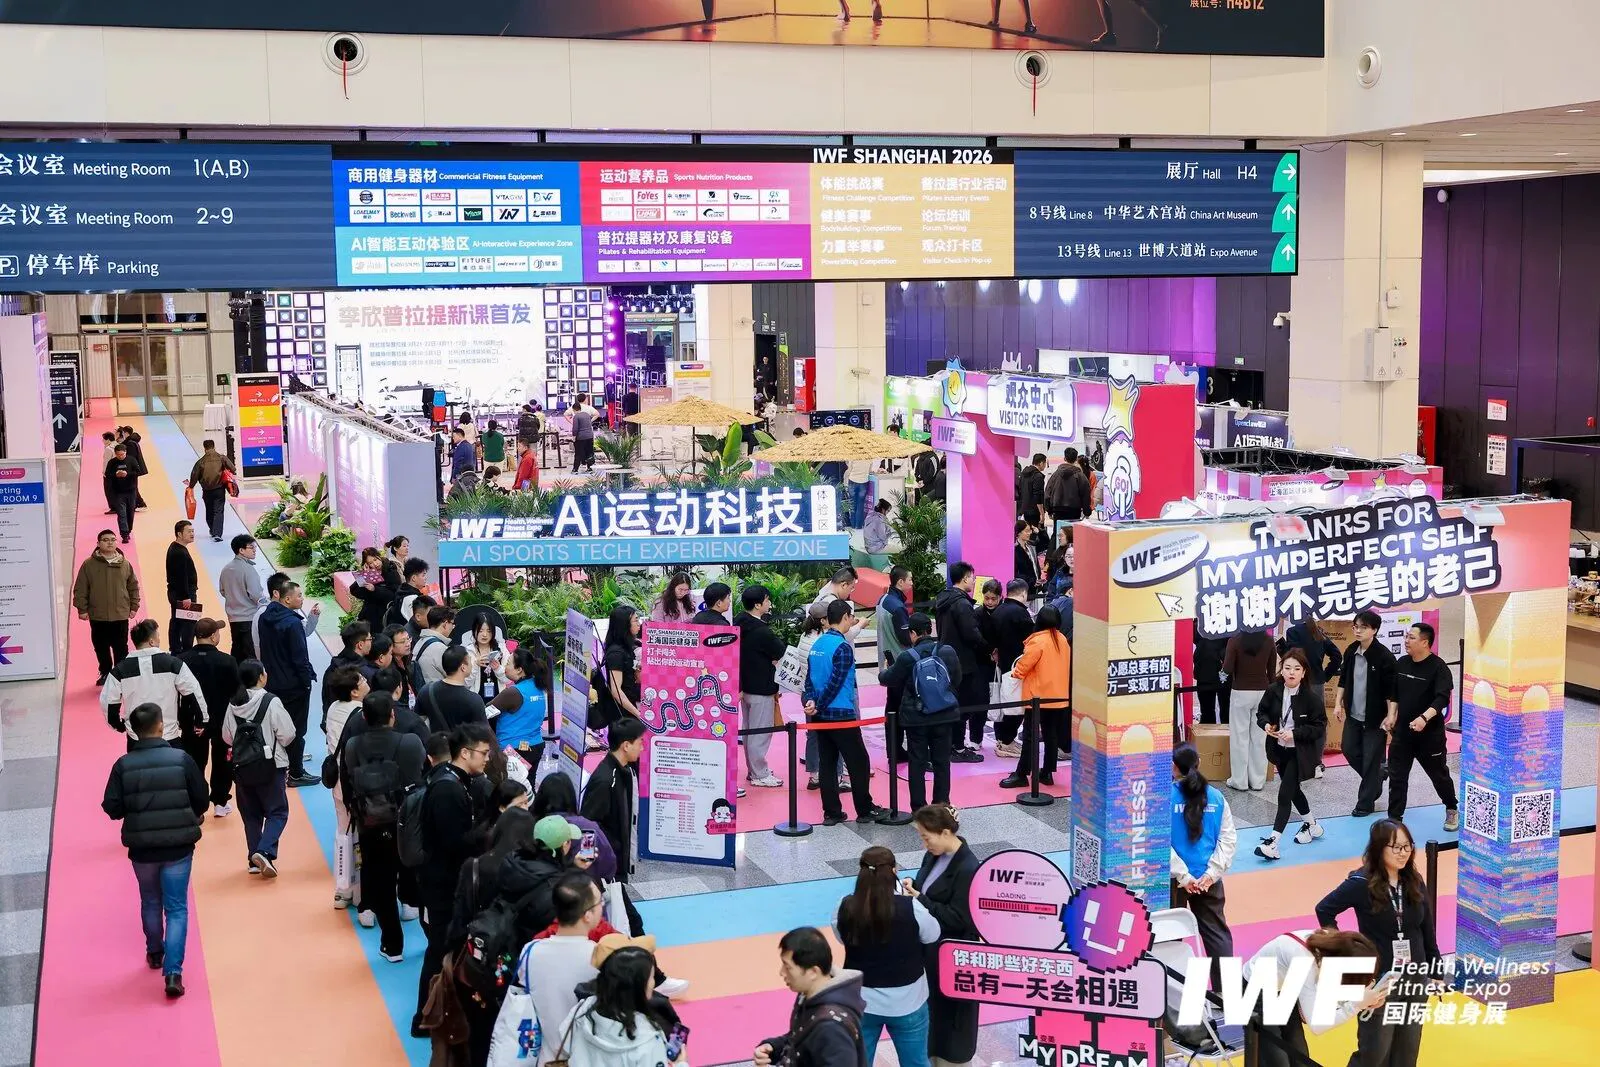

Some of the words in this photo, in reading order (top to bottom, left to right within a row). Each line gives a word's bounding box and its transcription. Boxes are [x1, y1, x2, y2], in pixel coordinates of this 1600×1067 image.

[0, 154, 66, 176] 会议室
[74, 163, 128, 178] Meeting
[131, 163, 170, 176] Room
[814, 148, 848, 164] IWF
[854, 148, 947, 164] SHANGHAI
[952, 149, 993, 164] 2026
[348, 168, 438, 184] 商用健身器材
[508, 173, 543, 181] Equipment
[600, 169, 668, 184] 运动营养品
[1166, 162, 1199, 180] 展厅
[1202, 169, 1220, 180] Hall
[1238, 166, 1257, 179] H4
[922, 176, 1008, 190] 普拉提行业活动
[0, 204, 68, 226] 会议室
[76, 213, 130, 227] Meeting
[134, 213, 173, 224] Room
[196, 207, 234, 225] 2~9
[1029, 205, 1066, 220] 8号线
[1070, 211, 1085, 219] Line
[1088, 211, 1093, 219] 8
[1104, 205, 1186, 220] 中华艺术宫站
[1190, 211, 1211, 219] China
[1213, 211, 1224, 219] Art
[1227, 211, 1258, 219] Museum
[351, 236, 470, 252] AI智能互动体验区
[597, 230, 733, 246] 普拉提器材及康复设备
[922, 239, 983, 252] 观众打卡区
[1057, 243, 1100, 258] 13号线
[1104, 249, 1120, 258] Line
[1122, 249, 1132, 258] 13
[1139, 243, 1206, 258] 世博大道站
[1210, 248, 1228, 259] Expo
[1230, 248, 1258, 257] Avenue
[26, 253, 100, 275] 停车库
[107, 262, 159, 276] Parking
[338, 303, 532, 328] 李欣普拉提新课首发
[1006, 381, 1054, 412] 观众中心
[1000, 410, 1029, 428] VISITOR
[1032, 414, 1062, 431] CENTER
[938, 426, 956, 442] IWF
[1115, 476, 1129, 493] GO!
[553, 487, 804, 537] AI运动科技
[1378, 502, 1433, 530] FOR
[450, 518, 504, 538] IWF
[462, 546, 480, 562] AI
[490, 544, 570, 562] SPORTS
[577, 544, 632, 560] TECH
[640, 541, 764, 559] EXPERIENCE
[773, 540, 828, 556] ZONE
[1122, 546, 1161, 574] IWF
[1202, 559, 1248, 588] MY
[1255, 532, 1416, 580] IMPERFECT
[1422, 523, 1487, 551] SELF
[1201, 546, 1496, 634] 谢谢不完美的老己
[647, 636, 698, 646] 上海国际健身展
[1107, 658, 1170, 677] 心愿总要有的
[1107, 676, 1170, 695] 万一实现了呢
[1132, 780, 1146, 880] FITNESS
[989, 869, 1025, 883] IWF
[953, 950, 1073, 976] 你和那些好东西
[954, 970, 1139, 1009] 总有一天会相遇
[1020, 1038, 1055, 1065] MY
